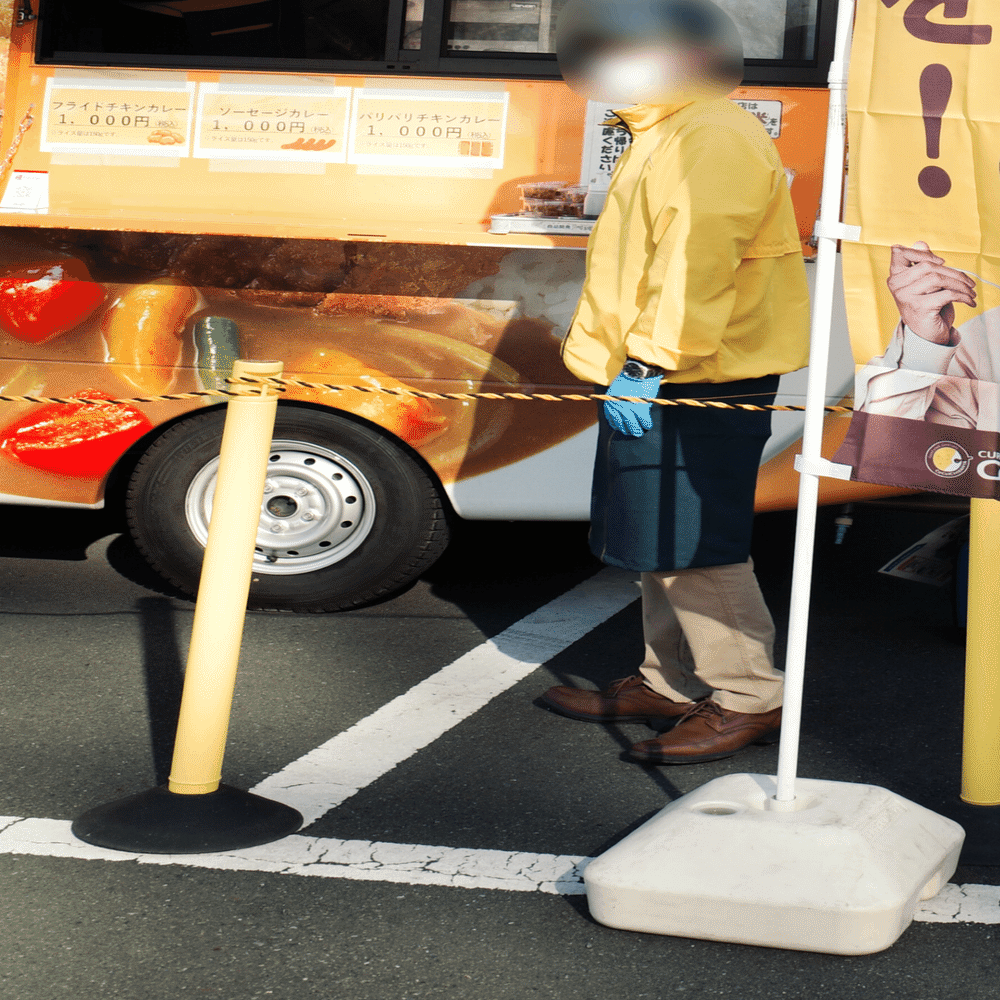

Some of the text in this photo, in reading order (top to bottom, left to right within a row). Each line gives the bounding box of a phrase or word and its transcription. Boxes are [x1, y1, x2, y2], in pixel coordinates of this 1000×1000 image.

[52, 101, 187, 113] フライドチキンカレー
[220, 107, 329, 118] ソーセージカレー
